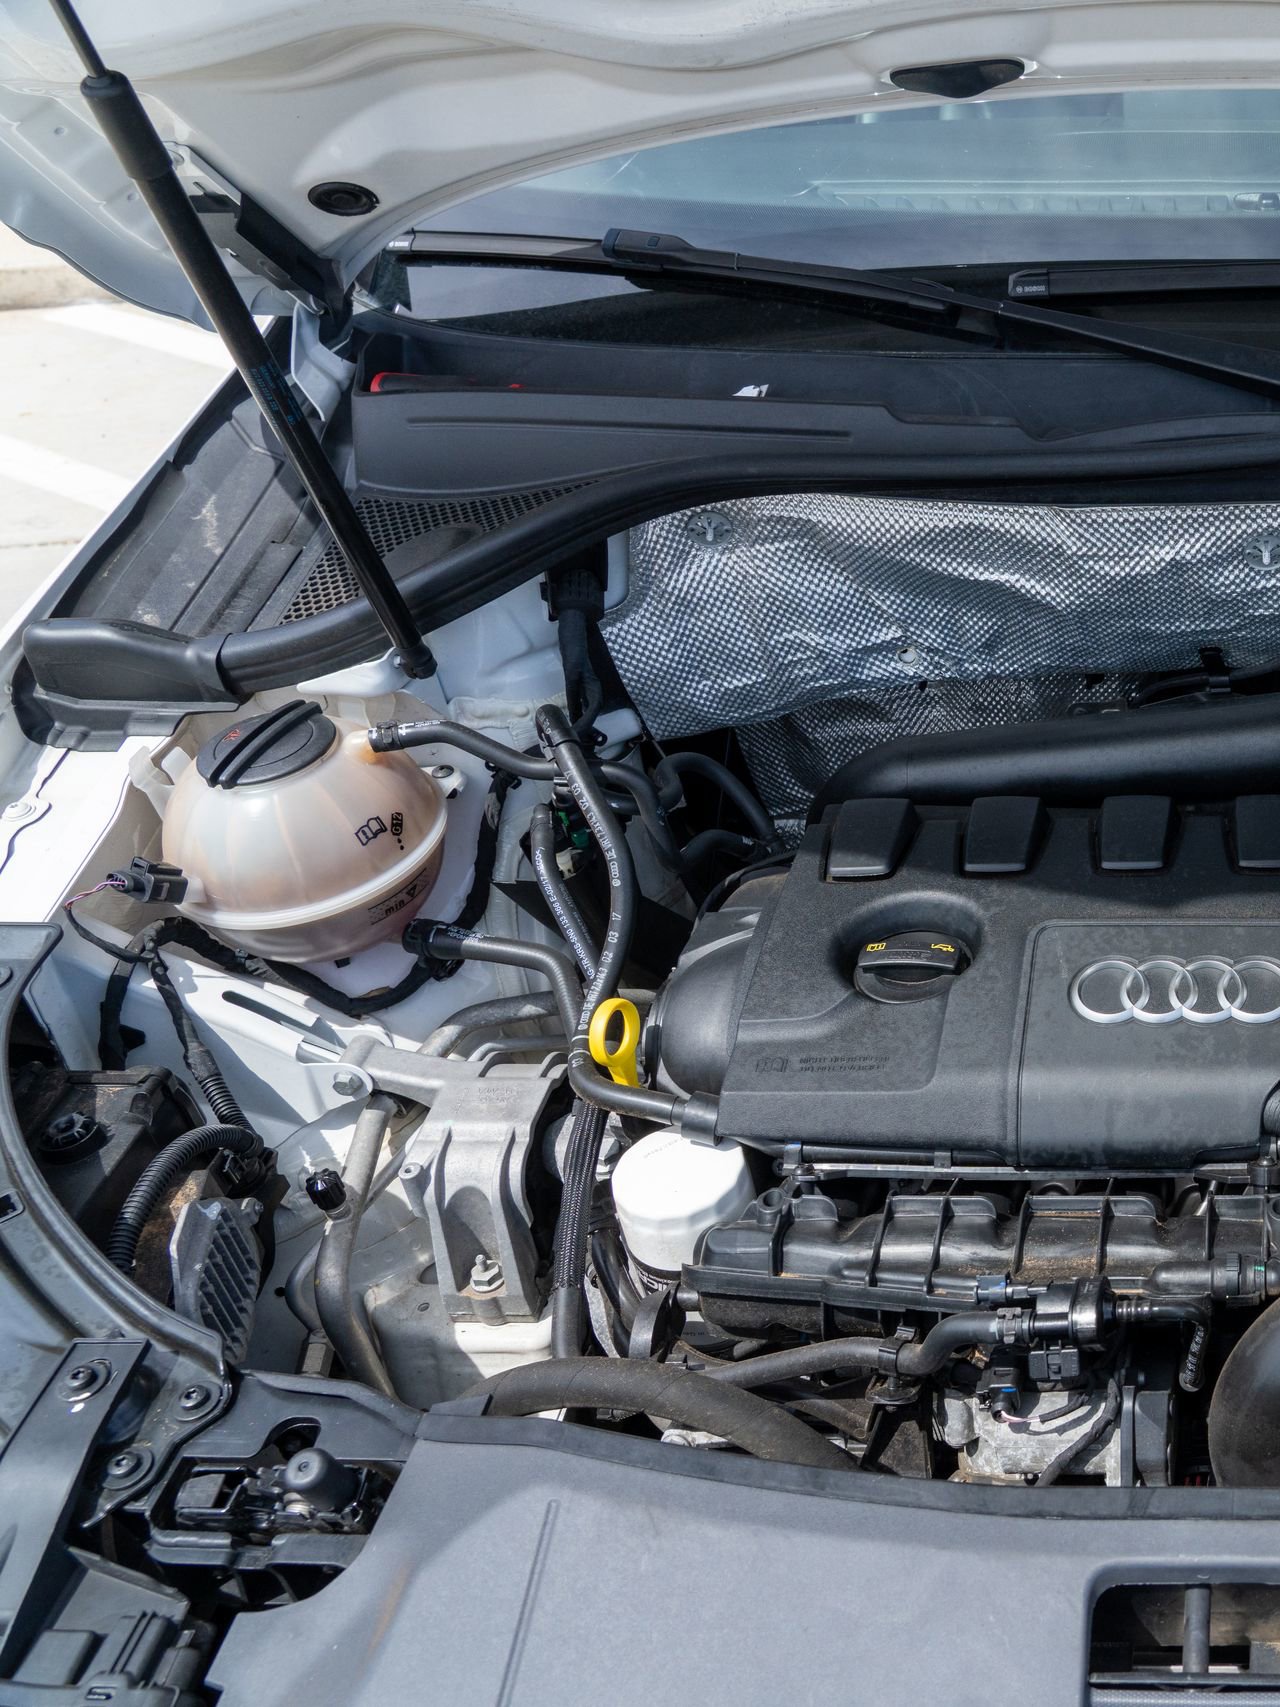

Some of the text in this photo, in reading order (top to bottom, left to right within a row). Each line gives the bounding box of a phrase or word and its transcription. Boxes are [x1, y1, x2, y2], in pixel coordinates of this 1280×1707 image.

[571, 784, 581, 796] 03
[579, 799, 589, 811] 02
[540, 877, 557, 902] E-02/17
[384, 898, 405, 916] min
[553, 902, 564, 916] 366
[559, 915, 570, 928] 133
[612, 912, 622, 921] 17
[608, 931, 619, 943] 03
[601, 951, 614, 963] 02
